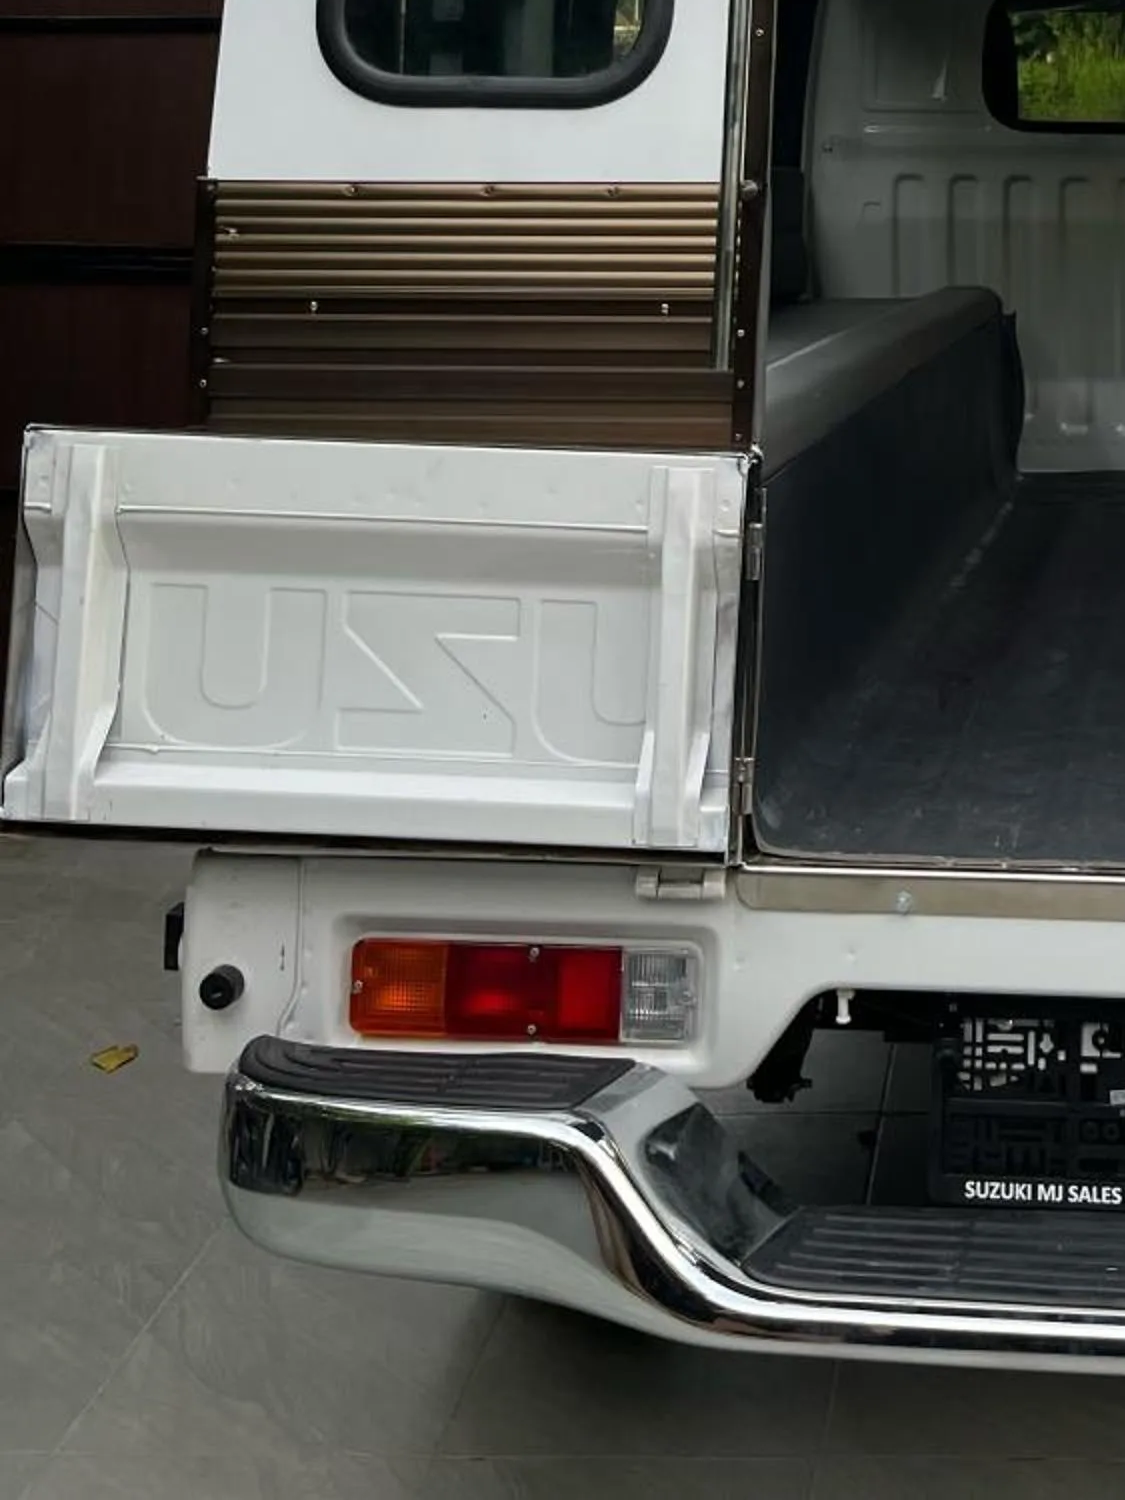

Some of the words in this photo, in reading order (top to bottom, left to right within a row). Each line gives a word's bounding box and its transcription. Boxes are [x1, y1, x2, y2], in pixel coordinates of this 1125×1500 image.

[964, 1180, 1033, 1201] SUZUKI
[1037, 1183, 1064, 1202] MJ
[1067, 1185, 1123, 1205] SALES
